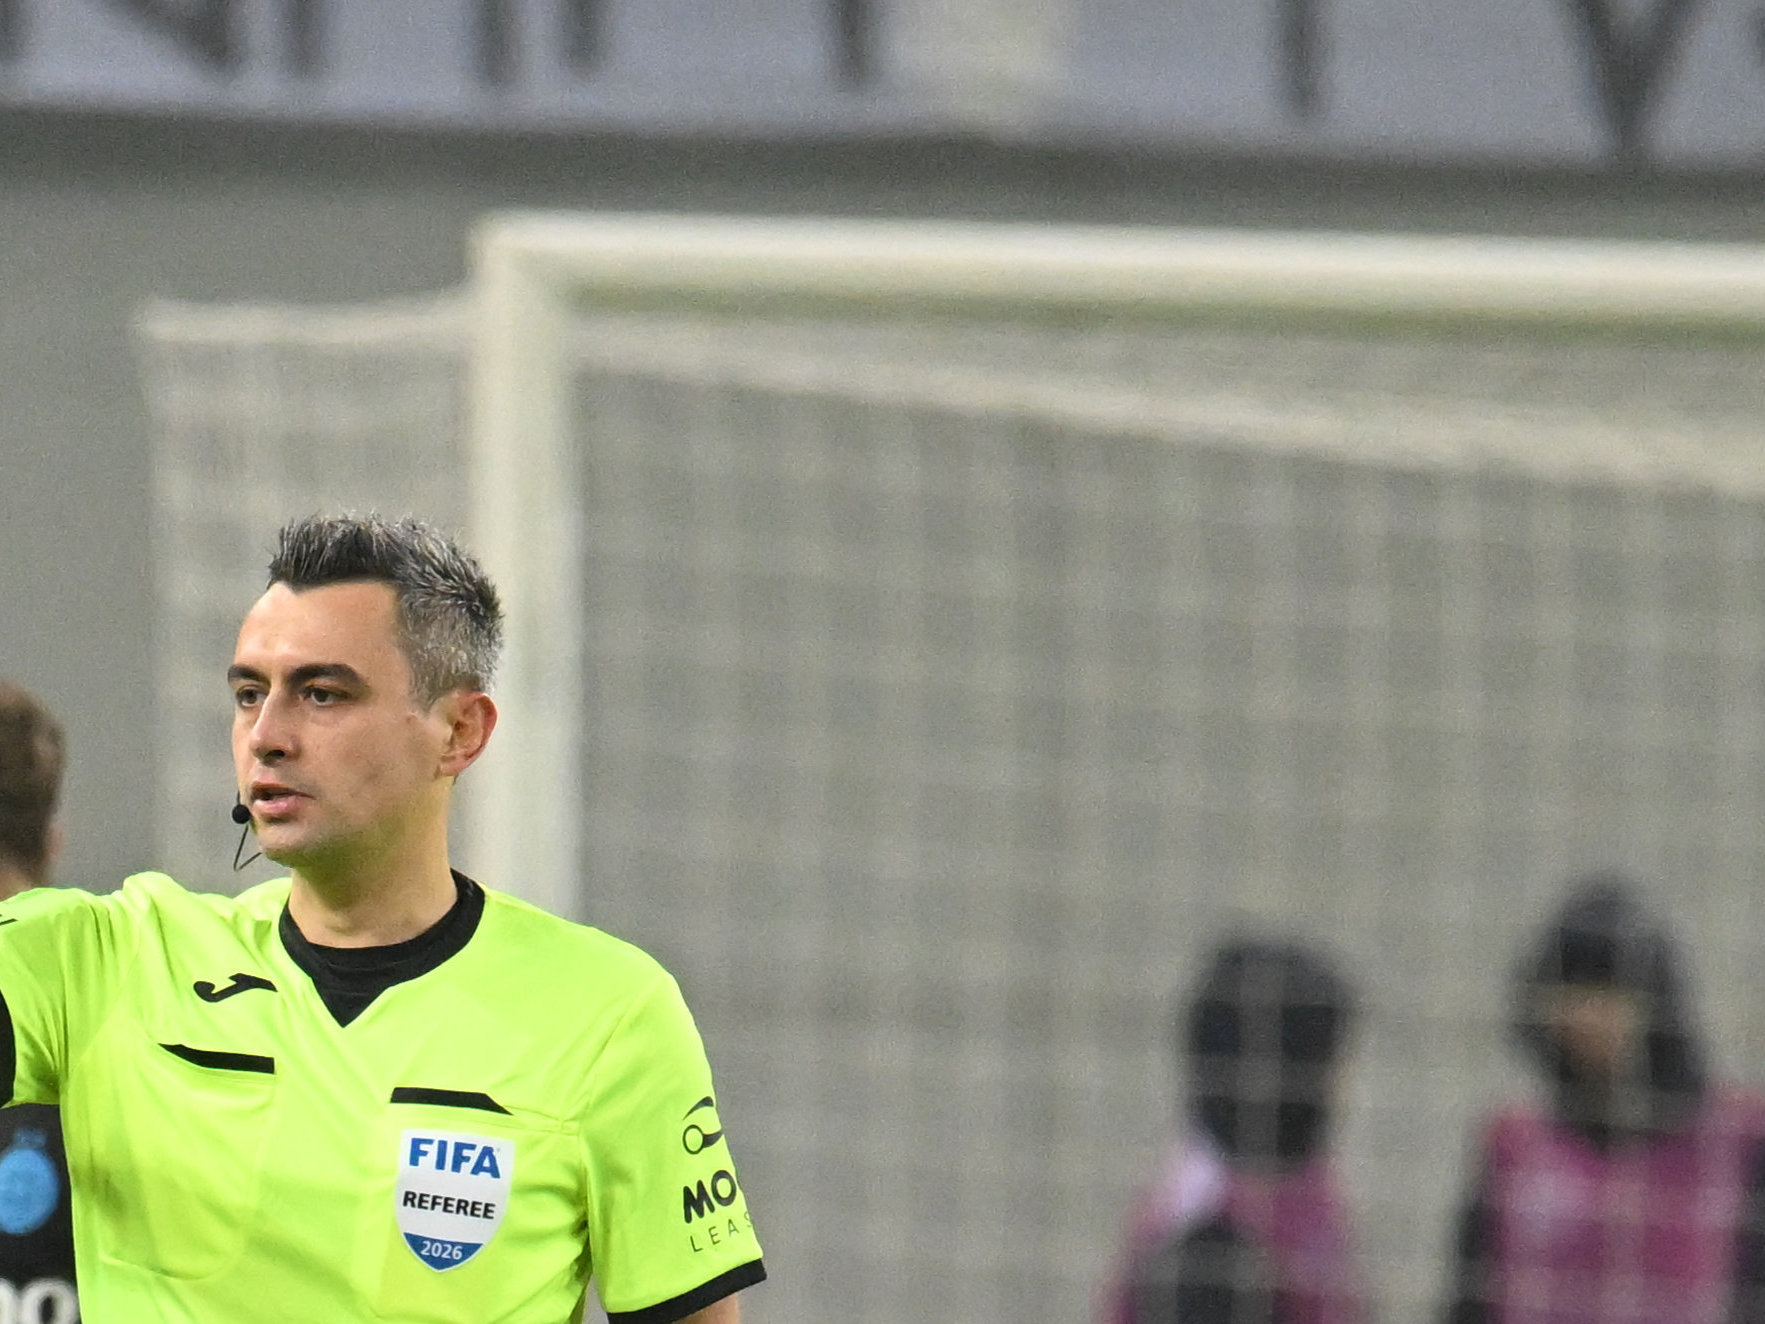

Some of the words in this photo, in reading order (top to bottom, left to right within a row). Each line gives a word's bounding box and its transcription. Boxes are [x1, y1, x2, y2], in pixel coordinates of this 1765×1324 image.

[408, 1137, 501, 1180] FIFA
[402, 1190, 496, 1220] REFEREE
[419, 1240, 463, 1261] 2026
